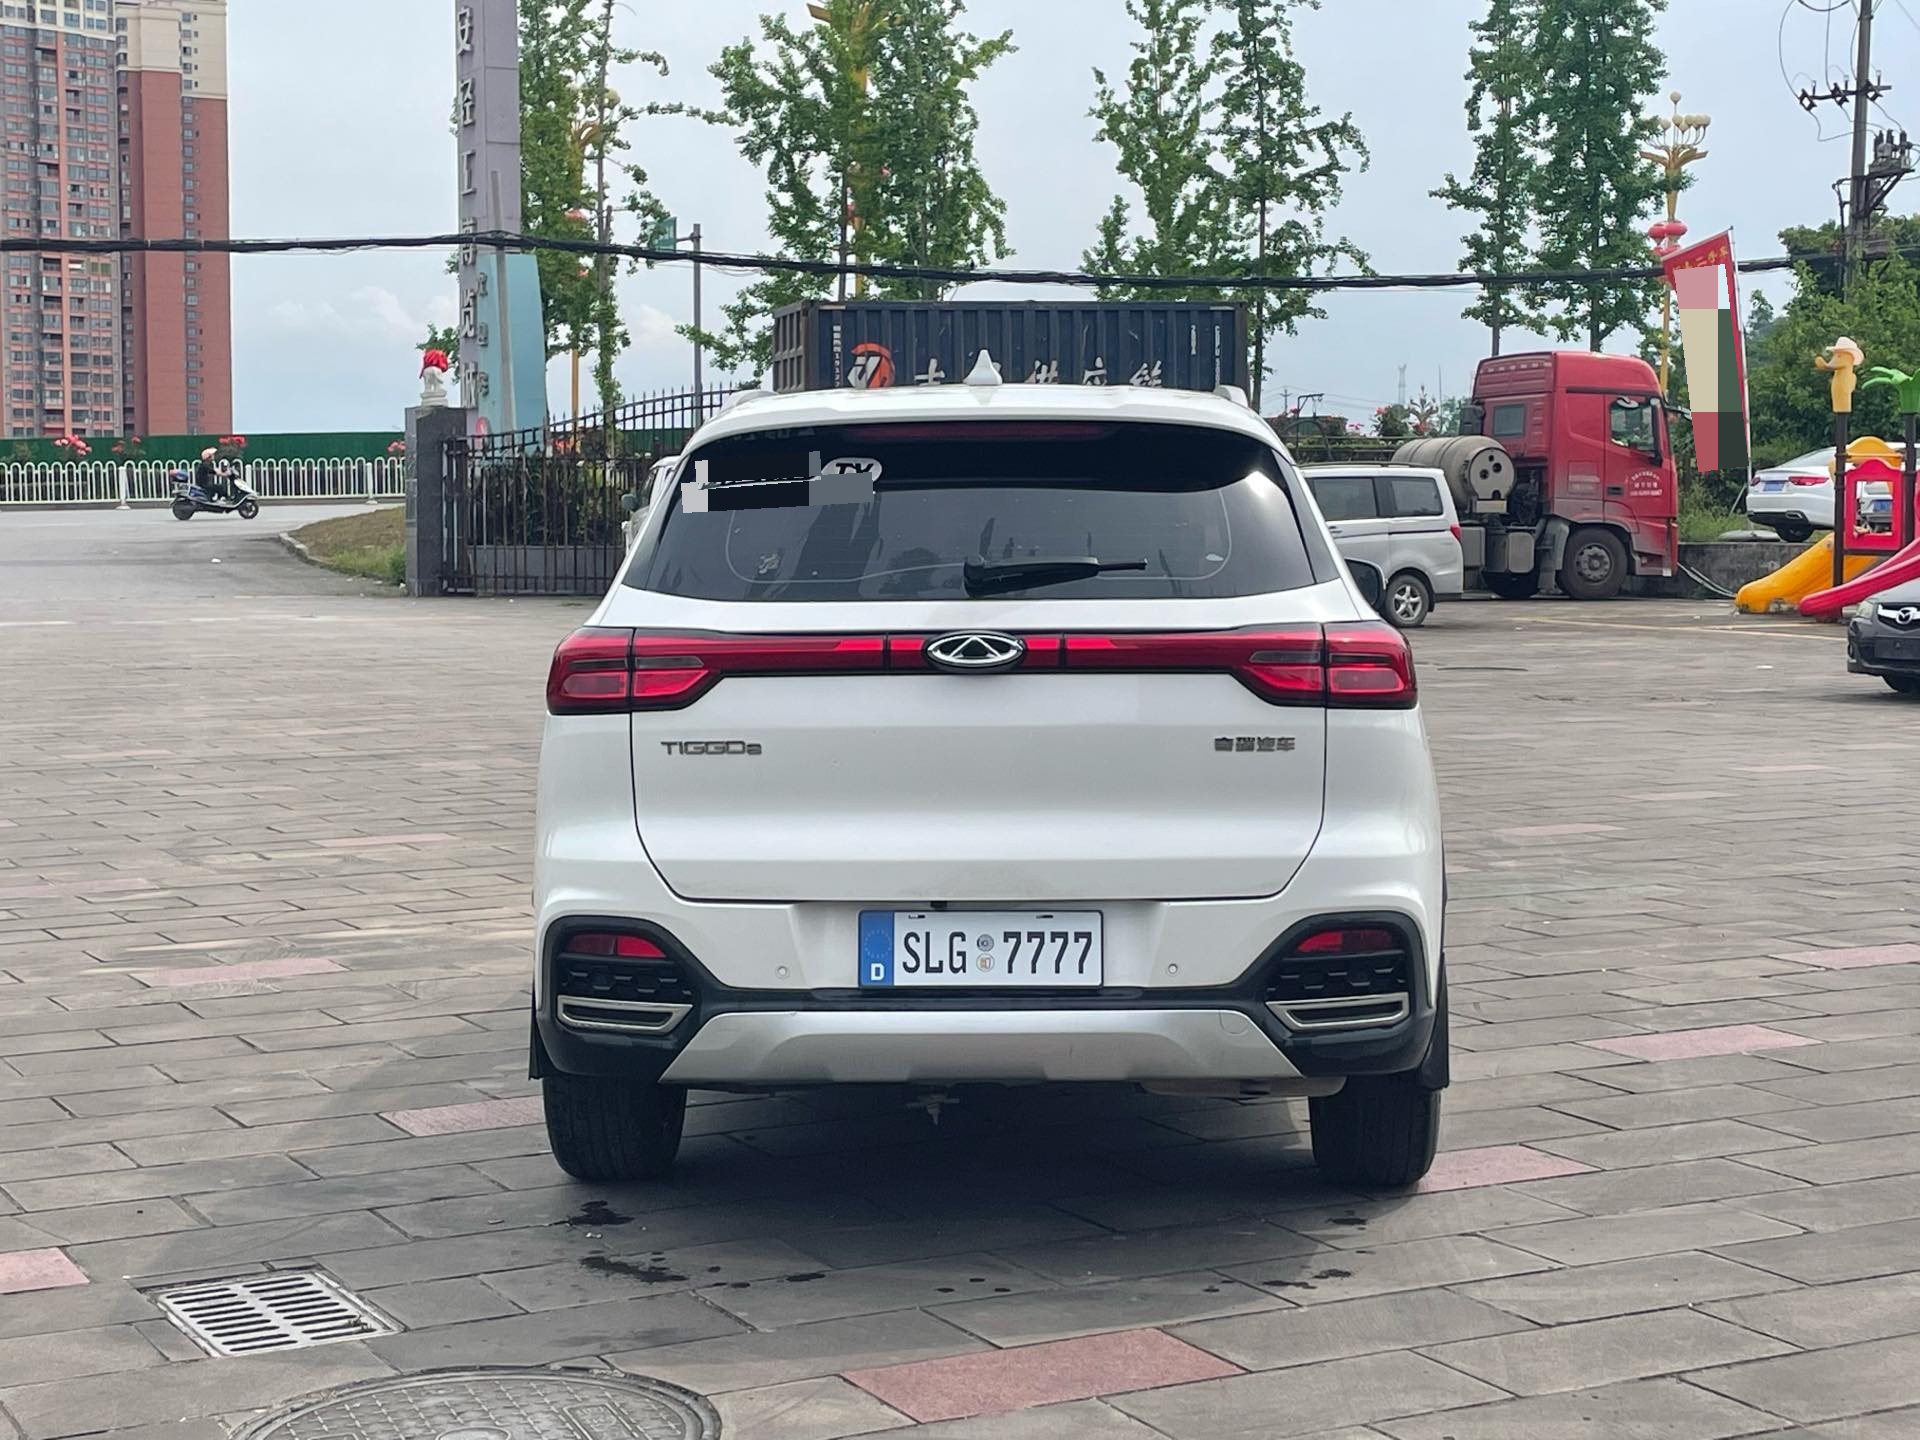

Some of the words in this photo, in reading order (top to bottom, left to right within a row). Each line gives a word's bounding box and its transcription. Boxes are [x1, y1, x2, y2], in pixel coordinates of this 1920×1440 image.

[902, 931, 967, 974] SLG
[1003, 931, 1092, 974] 7777
[870, 963, 885, 981] D
